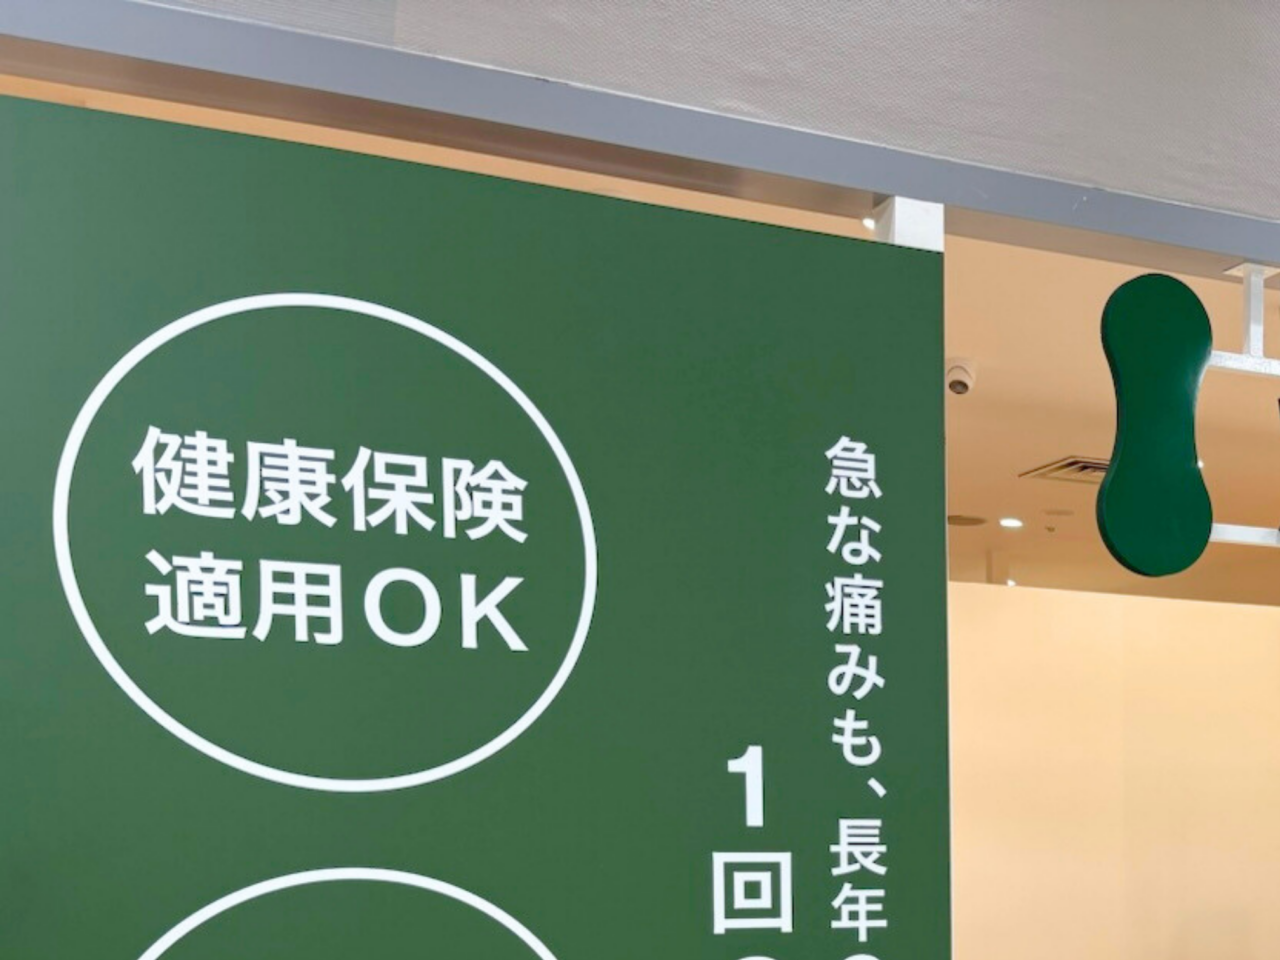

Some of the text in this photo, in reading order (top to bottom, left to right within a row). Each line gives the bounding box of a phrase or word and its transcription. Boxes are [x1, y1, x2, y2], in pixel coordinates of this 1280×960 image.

[131, 425, 529, 544] 健康保険
[143, 550, 529, 652] 適用OK
